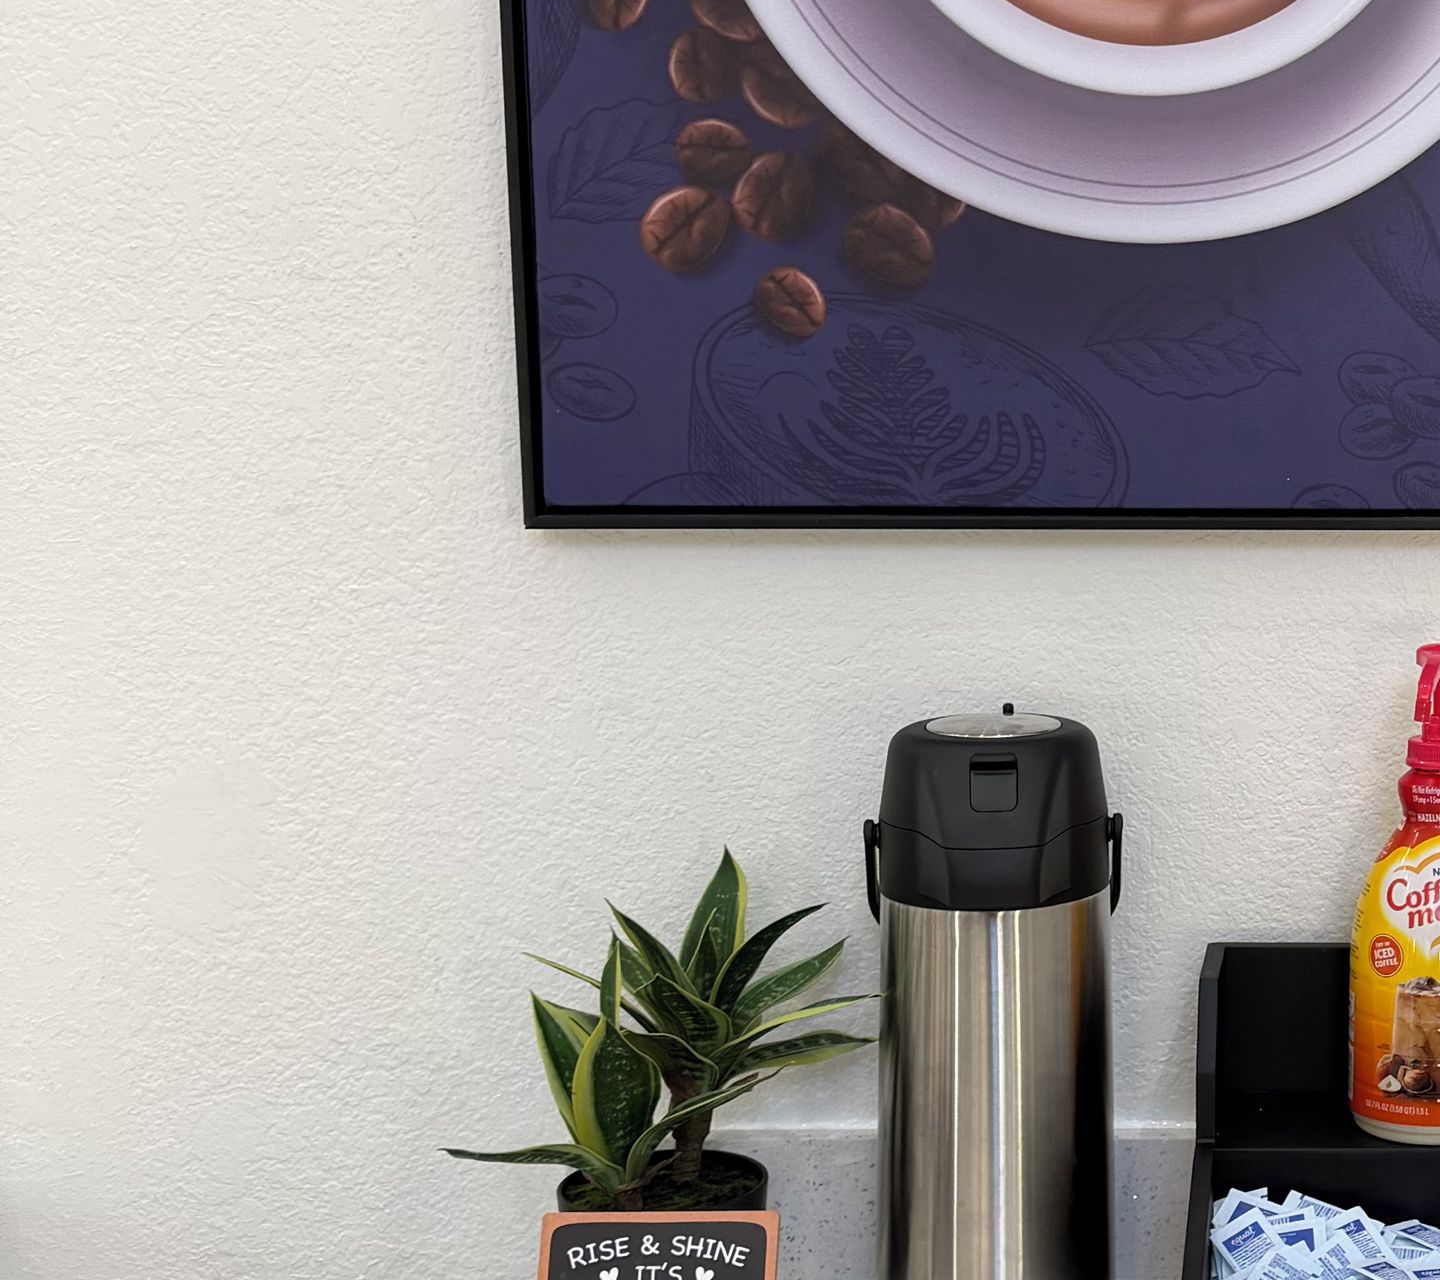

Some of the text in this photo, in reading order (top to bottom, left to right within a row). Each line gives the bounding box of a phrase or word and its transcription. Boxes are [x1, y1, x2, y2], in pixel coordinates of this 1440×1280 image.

[1374, 947, 1395, 960] ICED
[1375, 957, 1399, 968] COFFEE
[1231, 1226, 1256, 1247] equal
[567, 1235, 750, 1269] RISE & SHINE
